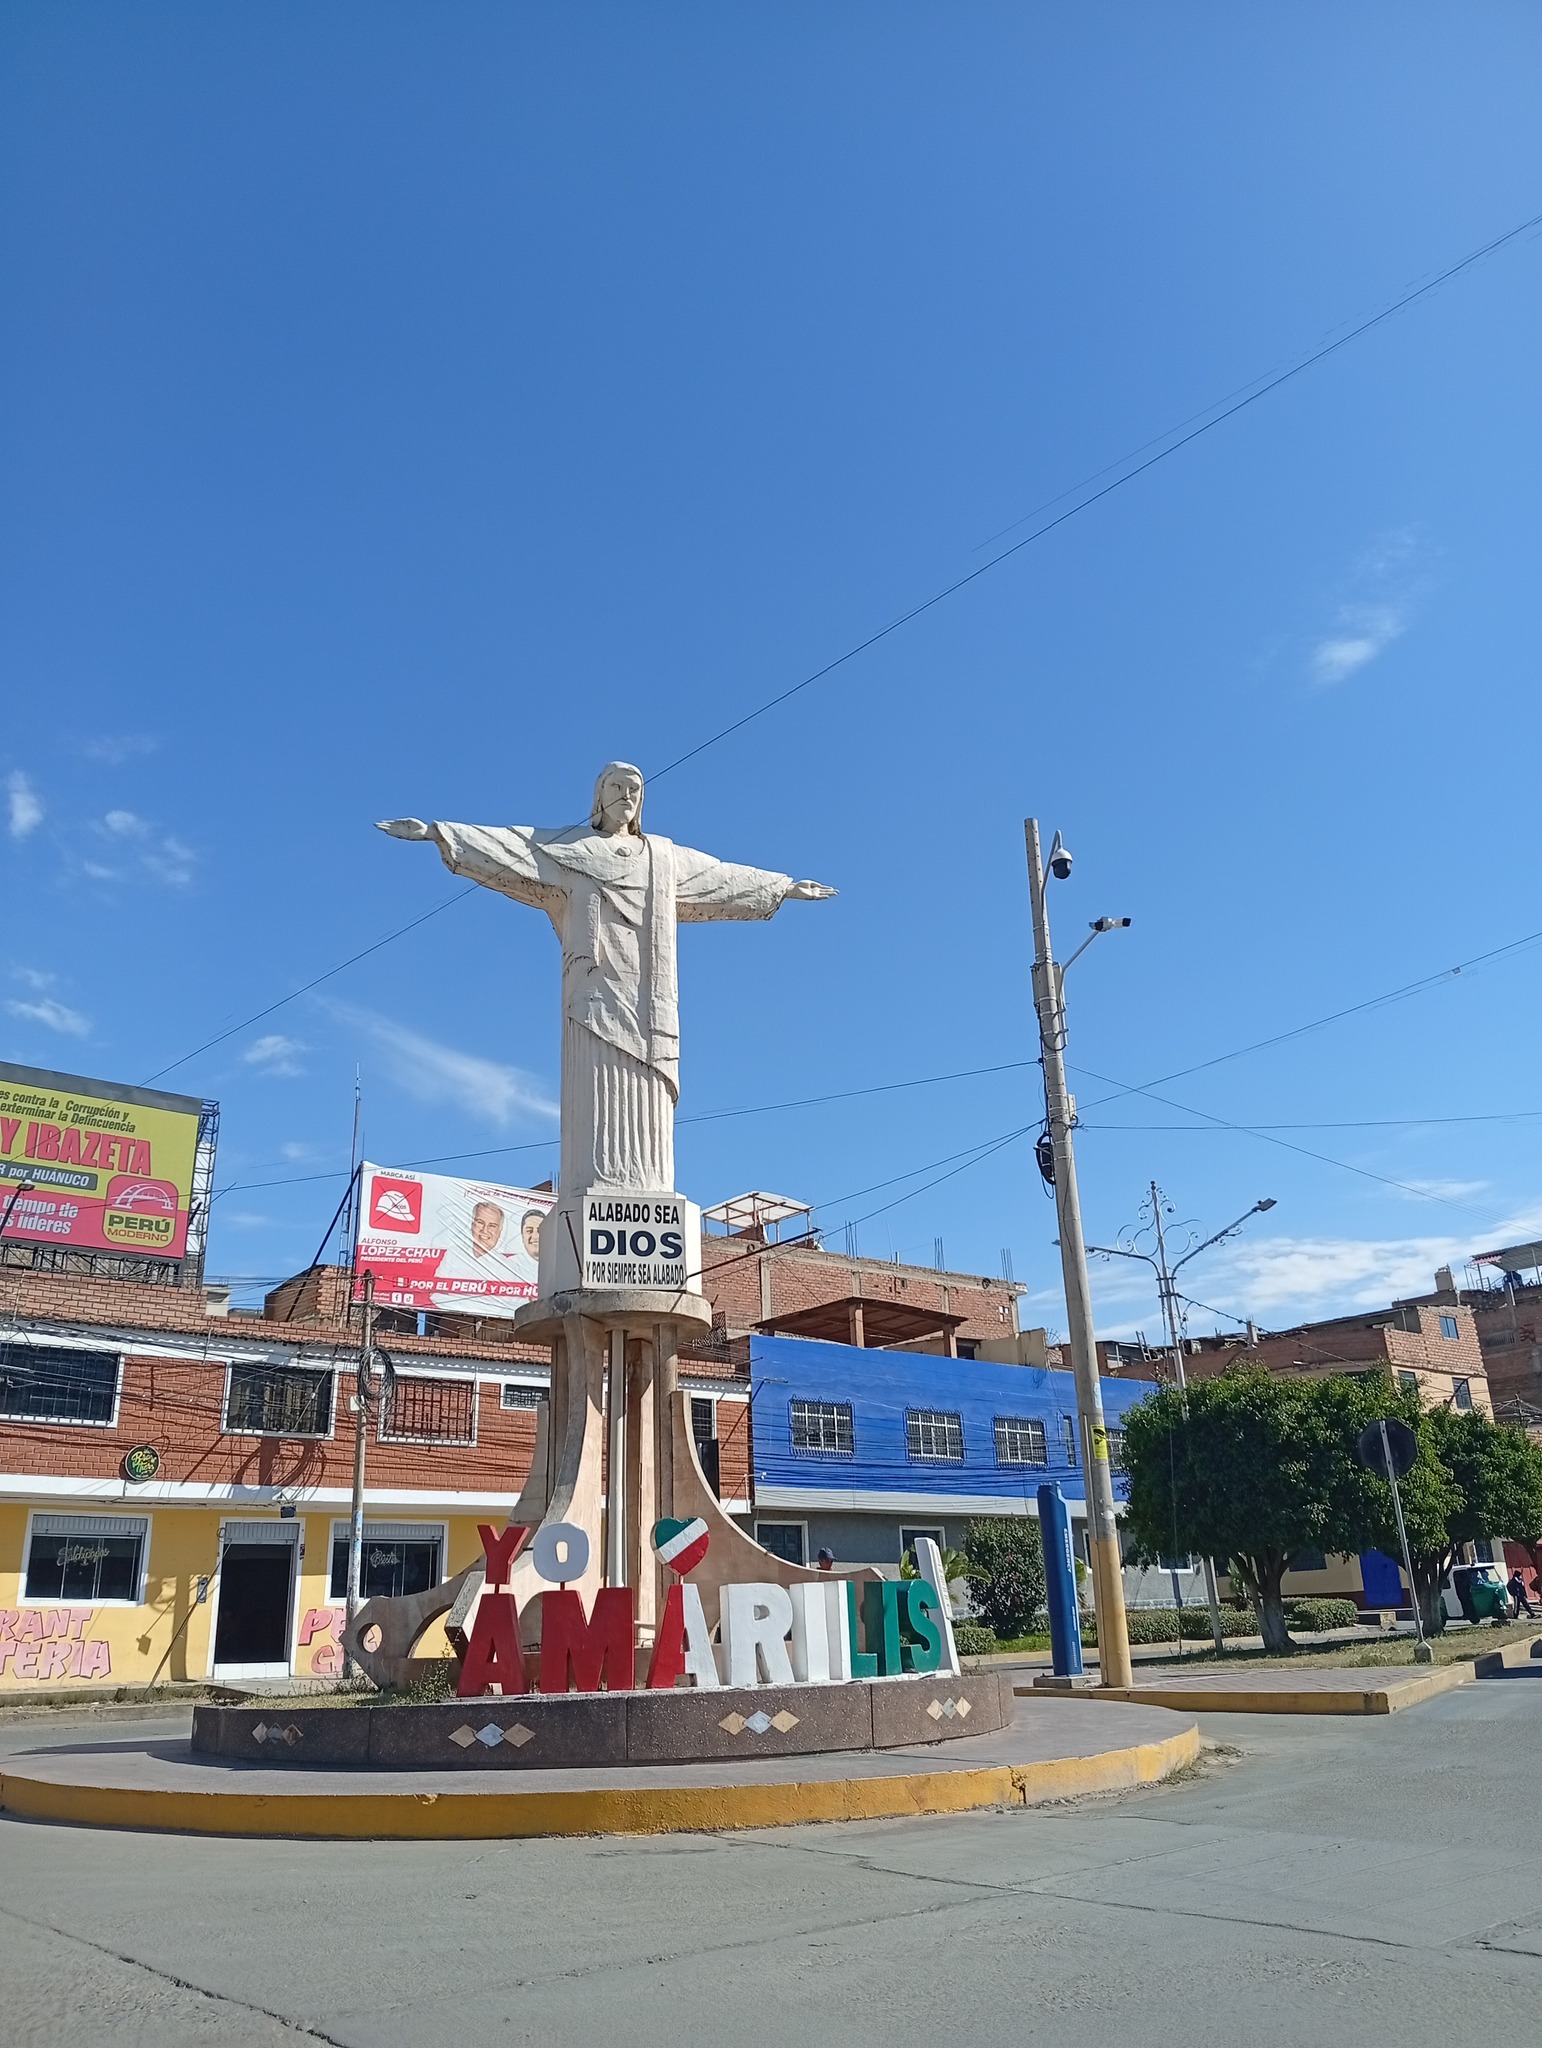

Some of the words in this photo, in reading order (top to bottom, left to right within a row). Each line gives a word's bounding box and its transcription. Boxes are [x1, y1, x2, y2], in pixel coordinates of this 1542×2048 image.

[0, 1102, 56, 1120] exterminar
[58, 1110, 68, 1122] la
[71, 1112, 136, 1133] Delincuencia
[12, 1092, 47, 1107] contra
[49, 1097, 60, 1109] la
[65, 1100, 120, 1120] Corrupción
[122, 1112, 130, 1122] y
[25, 1121, 151, 1176] IBAZETA
[8, 1167, 29, 1178] por
[31, 1168, 90, 1187] HUÁNUCO
[380, 1170, 403, 1179] MARCA
[17, 1212, 72, 1234] líderes
[59, 1203, 79, 1218] de
[589, 1202, 650, 1223] ALABADO
[654, 1205, 680, 1224] SEA
[107, 1228, 169, 1242] MODERNO
[108, 1214, 171, 1233] PERÚ
[590, 1229, 683, 1259] DIOS
[586, 1261, 591, 1282] Y
[592, 1261, 606, 1283] POR
[607, 1262, 636, 1284] SIEMPRE
[638, 1263, 652, 1284] SEA
[652, 1264, 684, 1286] ALABADO
[410, 1280, 434, 1290] POR
[436, 1282, 449, 1290] EL
[452, 1279, 487, 1293] PERÚ
[490, 1285, 498, 1294] Y
[499, 1286, 521, 1295] POR
[477, 1523, 590, 1585] YO
[0, 1609, 94, 1641] RANT
[456, 1578, 941, 1697] AMARILIS
[0, 1641, 112, 1681] TERIA
